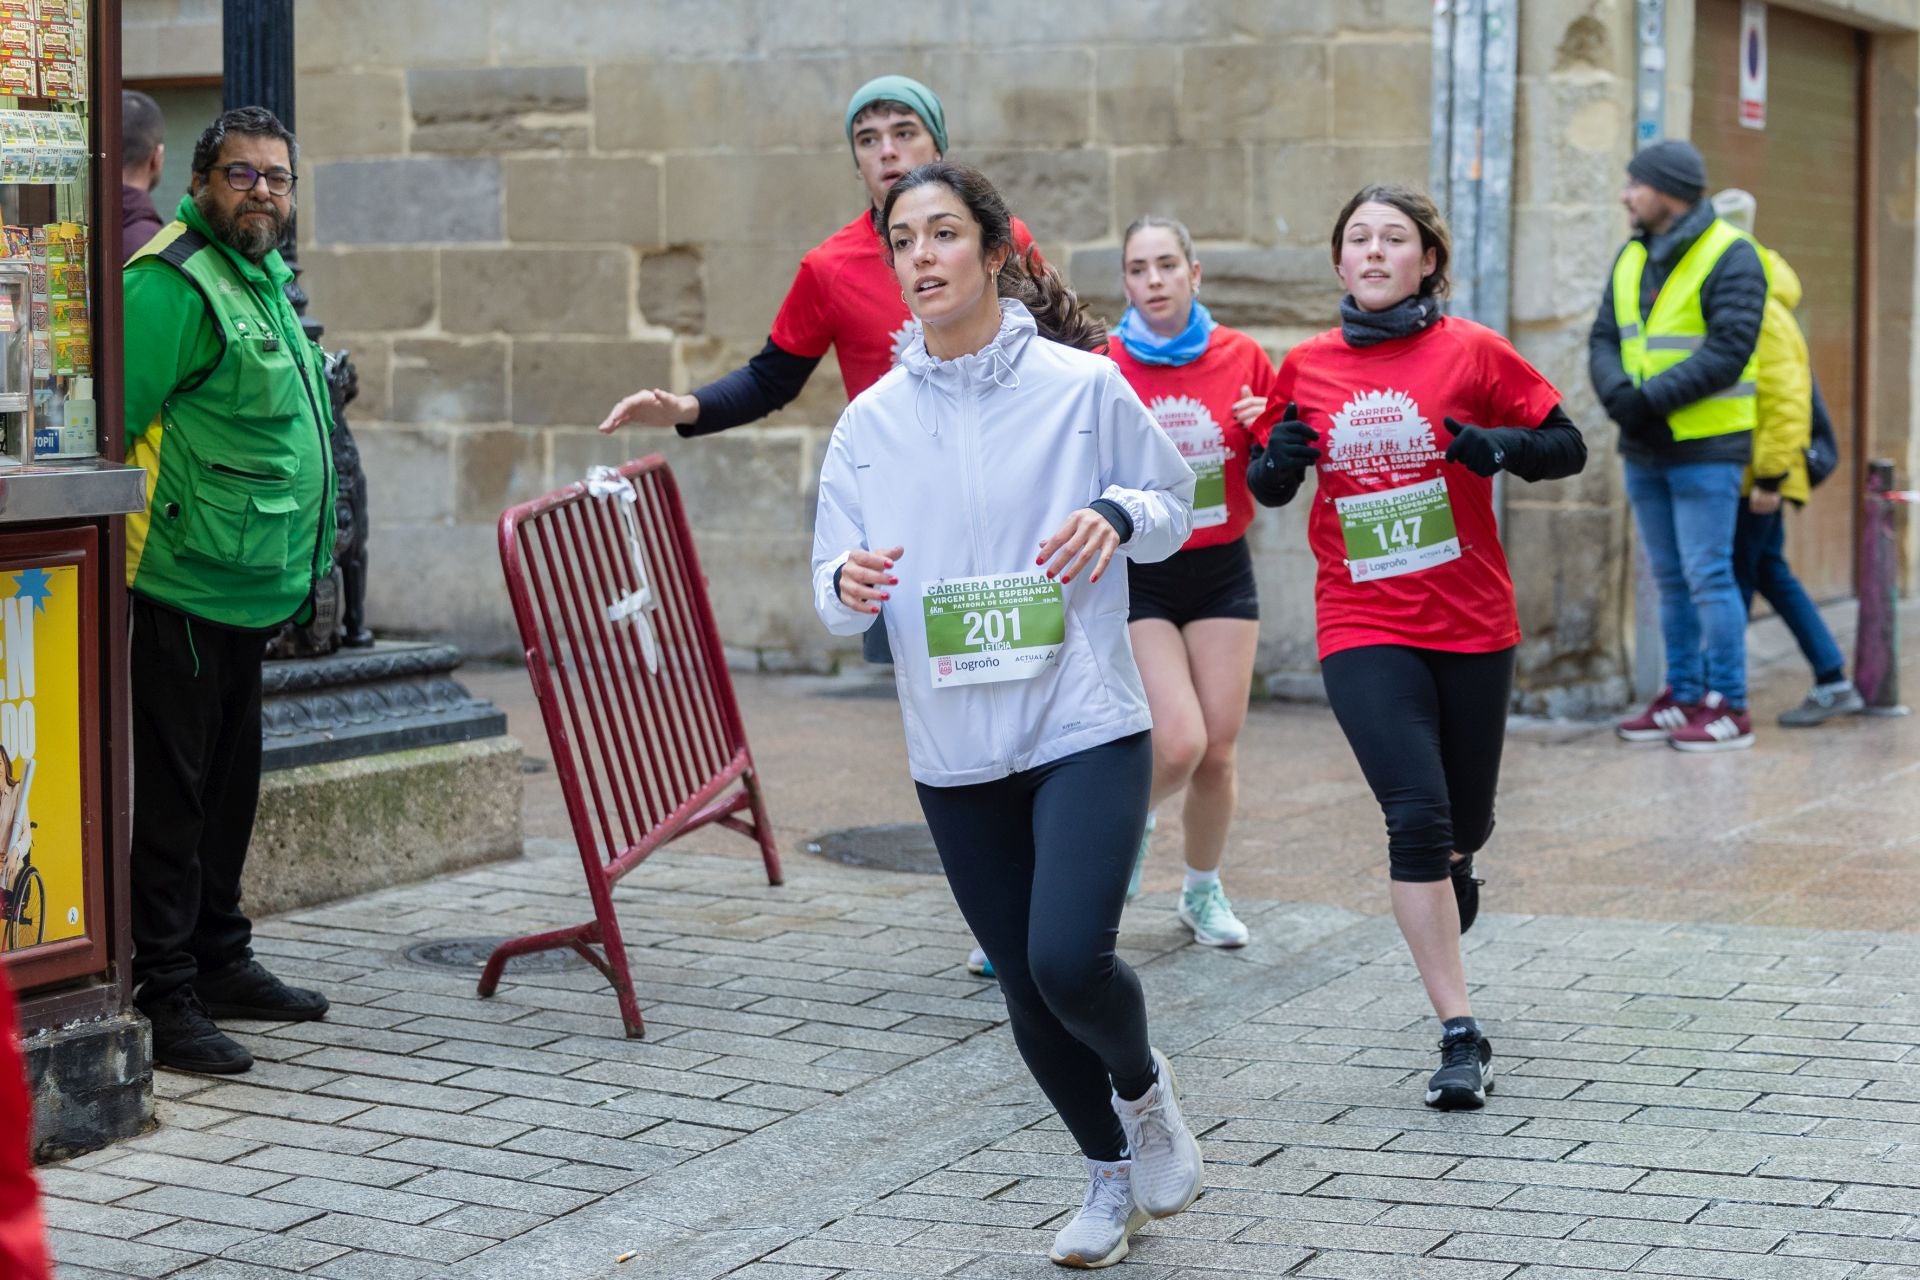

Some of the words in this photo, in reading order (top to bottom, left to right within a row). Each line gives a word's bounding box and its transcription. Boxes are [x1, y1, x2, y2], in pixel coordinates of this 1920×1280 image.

[1350, 405, 1402, 417] CARRERA
[1351, 416, 1400, 426] POPULAR
[1354, 458, 1370, 469] DE
[1372, 456, 1388, 466] LA
[1390, 450, 1446, 465] ESPERANZ
[1380, 466, 1392, 474] DE
[1341, 499, 1390, 513] CARRERA
[1392, 484, 1444, 506] POPULAR
[1398, 494, 1444, 511] ESPERANZA
[1372, 516, 1423, 550] 147
[1369, 558, 1408, 572] Logroño
[928, 581, 990, 596] CARRERA
[932, 592, 966, 604] VIRGEN
[968, 593, 980, 602] DE
[984, 591, 996, 600] LA
[999, 586, 1054, 598] ESPERANZA
[953, 600, 985, 610] PATRONA
[1000, 596, 1034, 605] LOGROÑO
[963, 608, 1022, 646] 201
[981, 641, 1012, 652] LETICIA
[955, 657, 1000, 672] Logroño
[1015, 654, 1044, 662] ACTUAL
